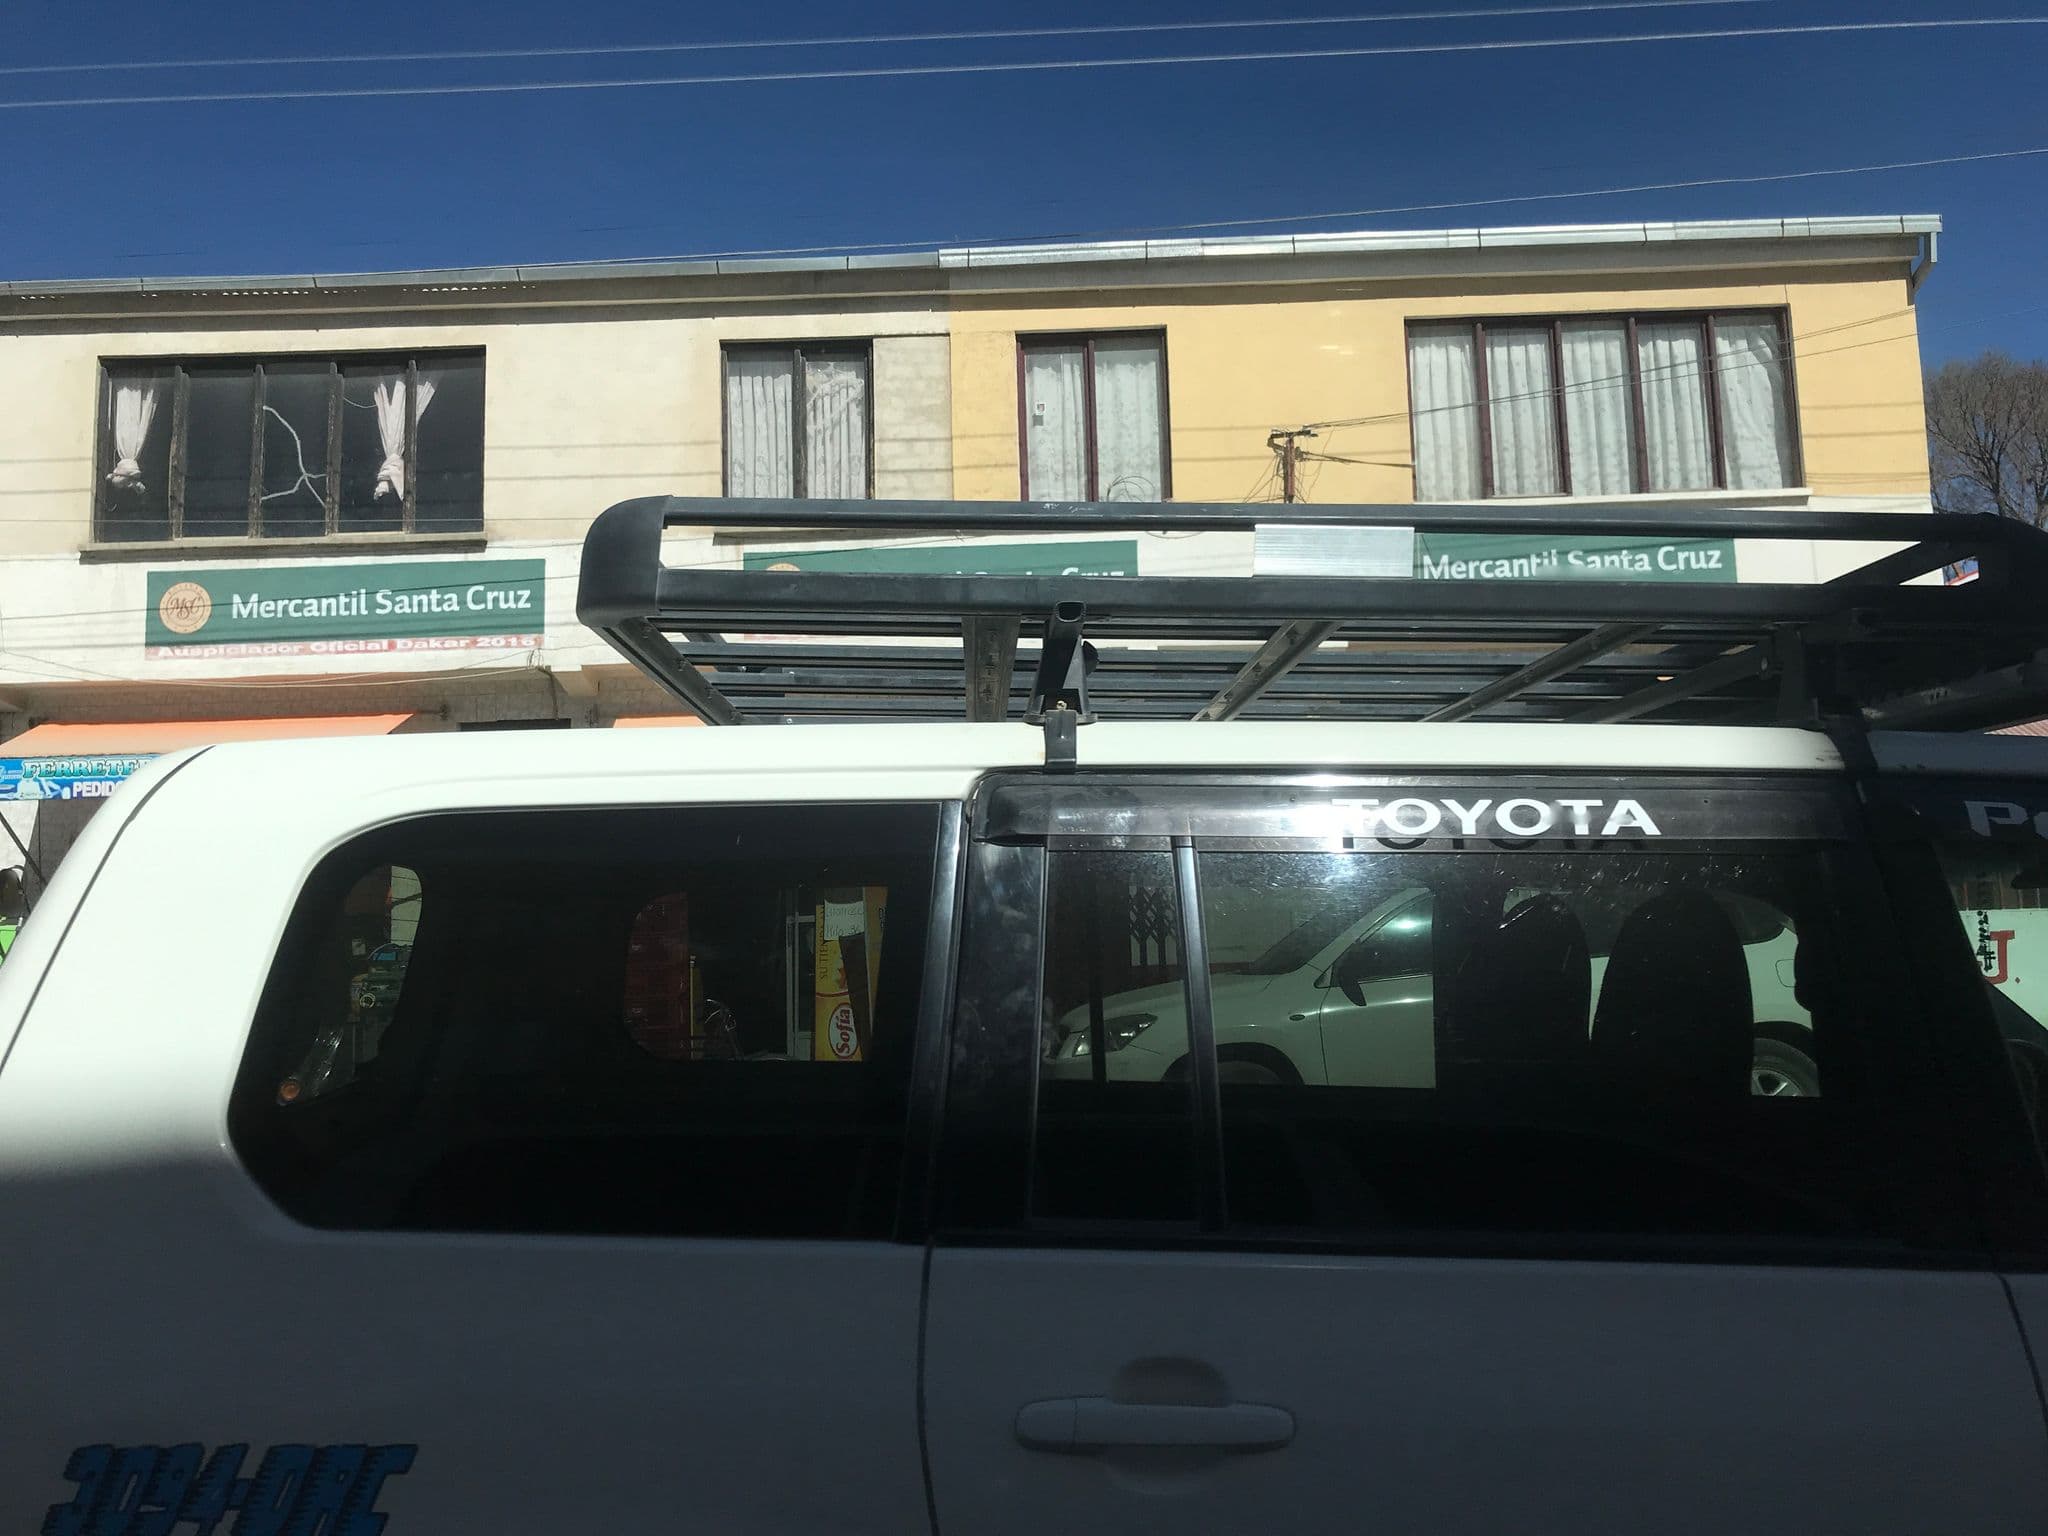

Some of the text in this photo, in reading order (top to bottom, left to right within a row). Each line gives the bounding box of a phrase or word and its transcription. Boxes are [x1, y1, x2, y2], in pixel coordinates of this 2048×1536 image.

[1423, 549, 1558, 579] Mercantil
[1657, 546, 1721, 571] Cruz
[232, 588, 368, 619] Mercantil
[375, 588, 459, 615] Santa
[466, 585, 531, 611] Cruz
[397, 637, 470, 650] Dakar
[476, 635, 536, 648] 2016
[73, 780, 121, 798] PEDID
[1331, 797, 1662, 837] TOYOTA
